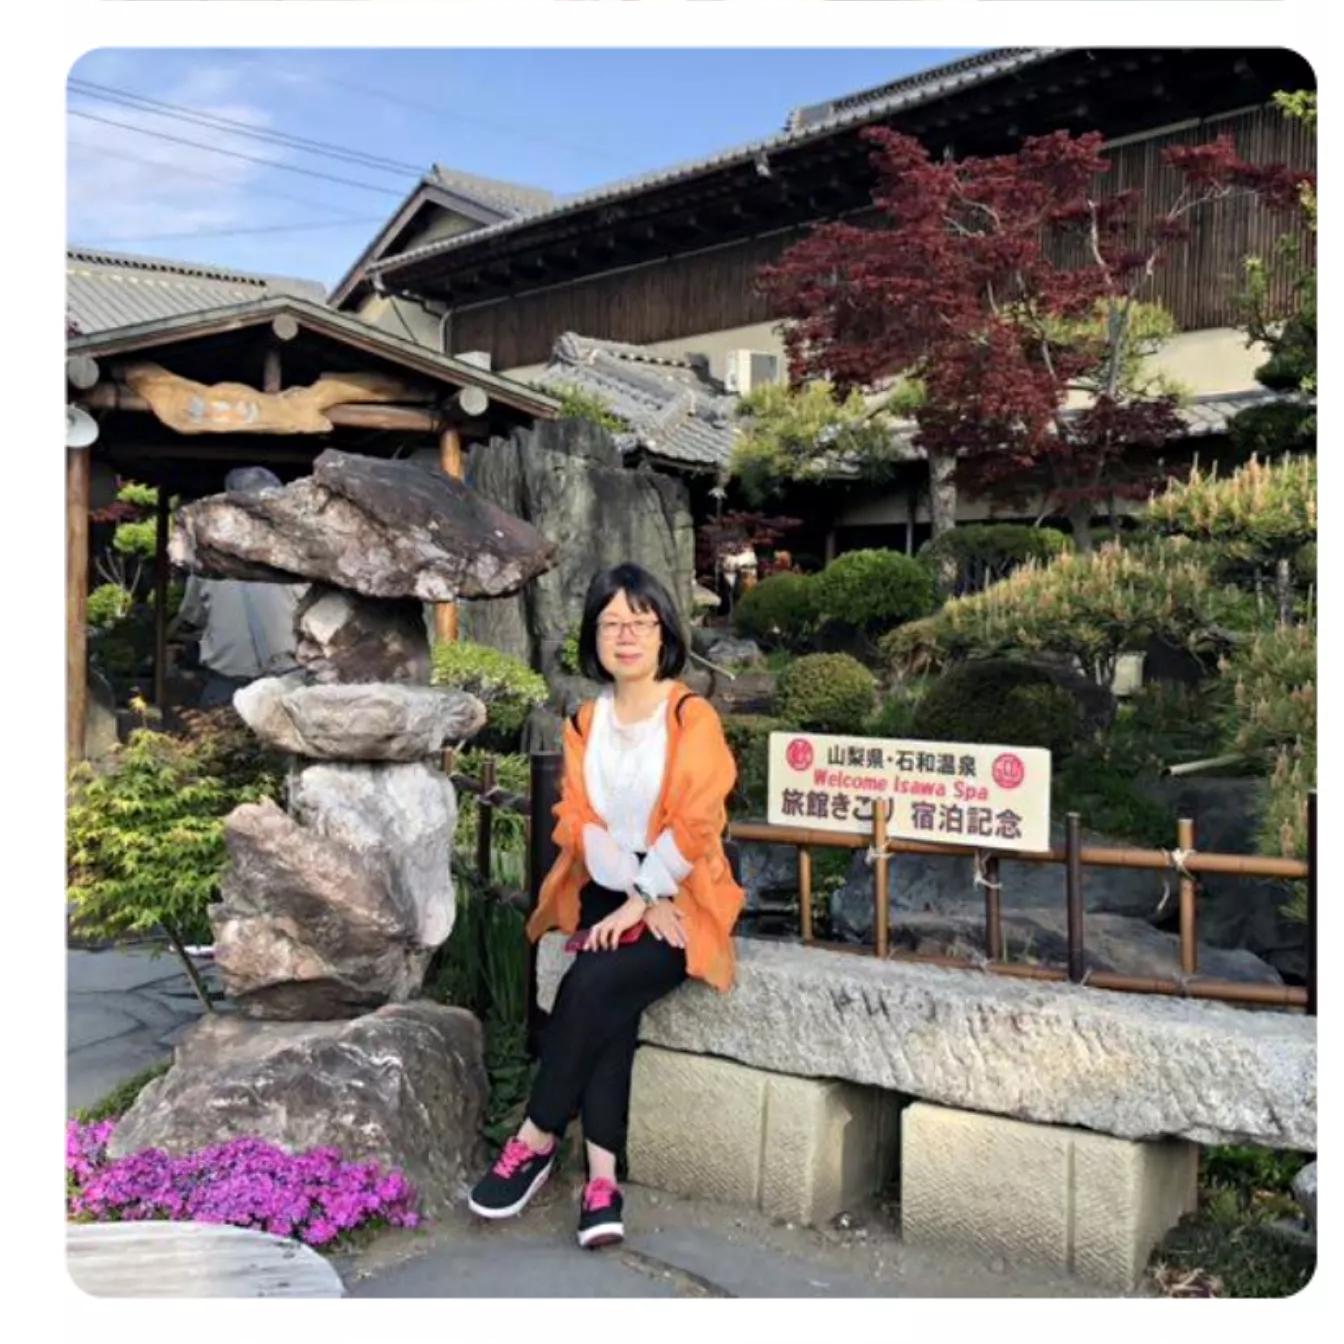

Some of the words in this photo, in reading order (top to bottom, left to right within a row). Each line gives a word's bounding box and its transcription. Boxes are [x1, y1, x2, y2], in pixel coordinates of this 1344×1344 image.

[813, 769, 888, 793] Welcome
[894, 780, 946, 798] Isawa
[953, 780, 989, 802] Spa
[910, 800, 1023, 840] 宿泊記念
